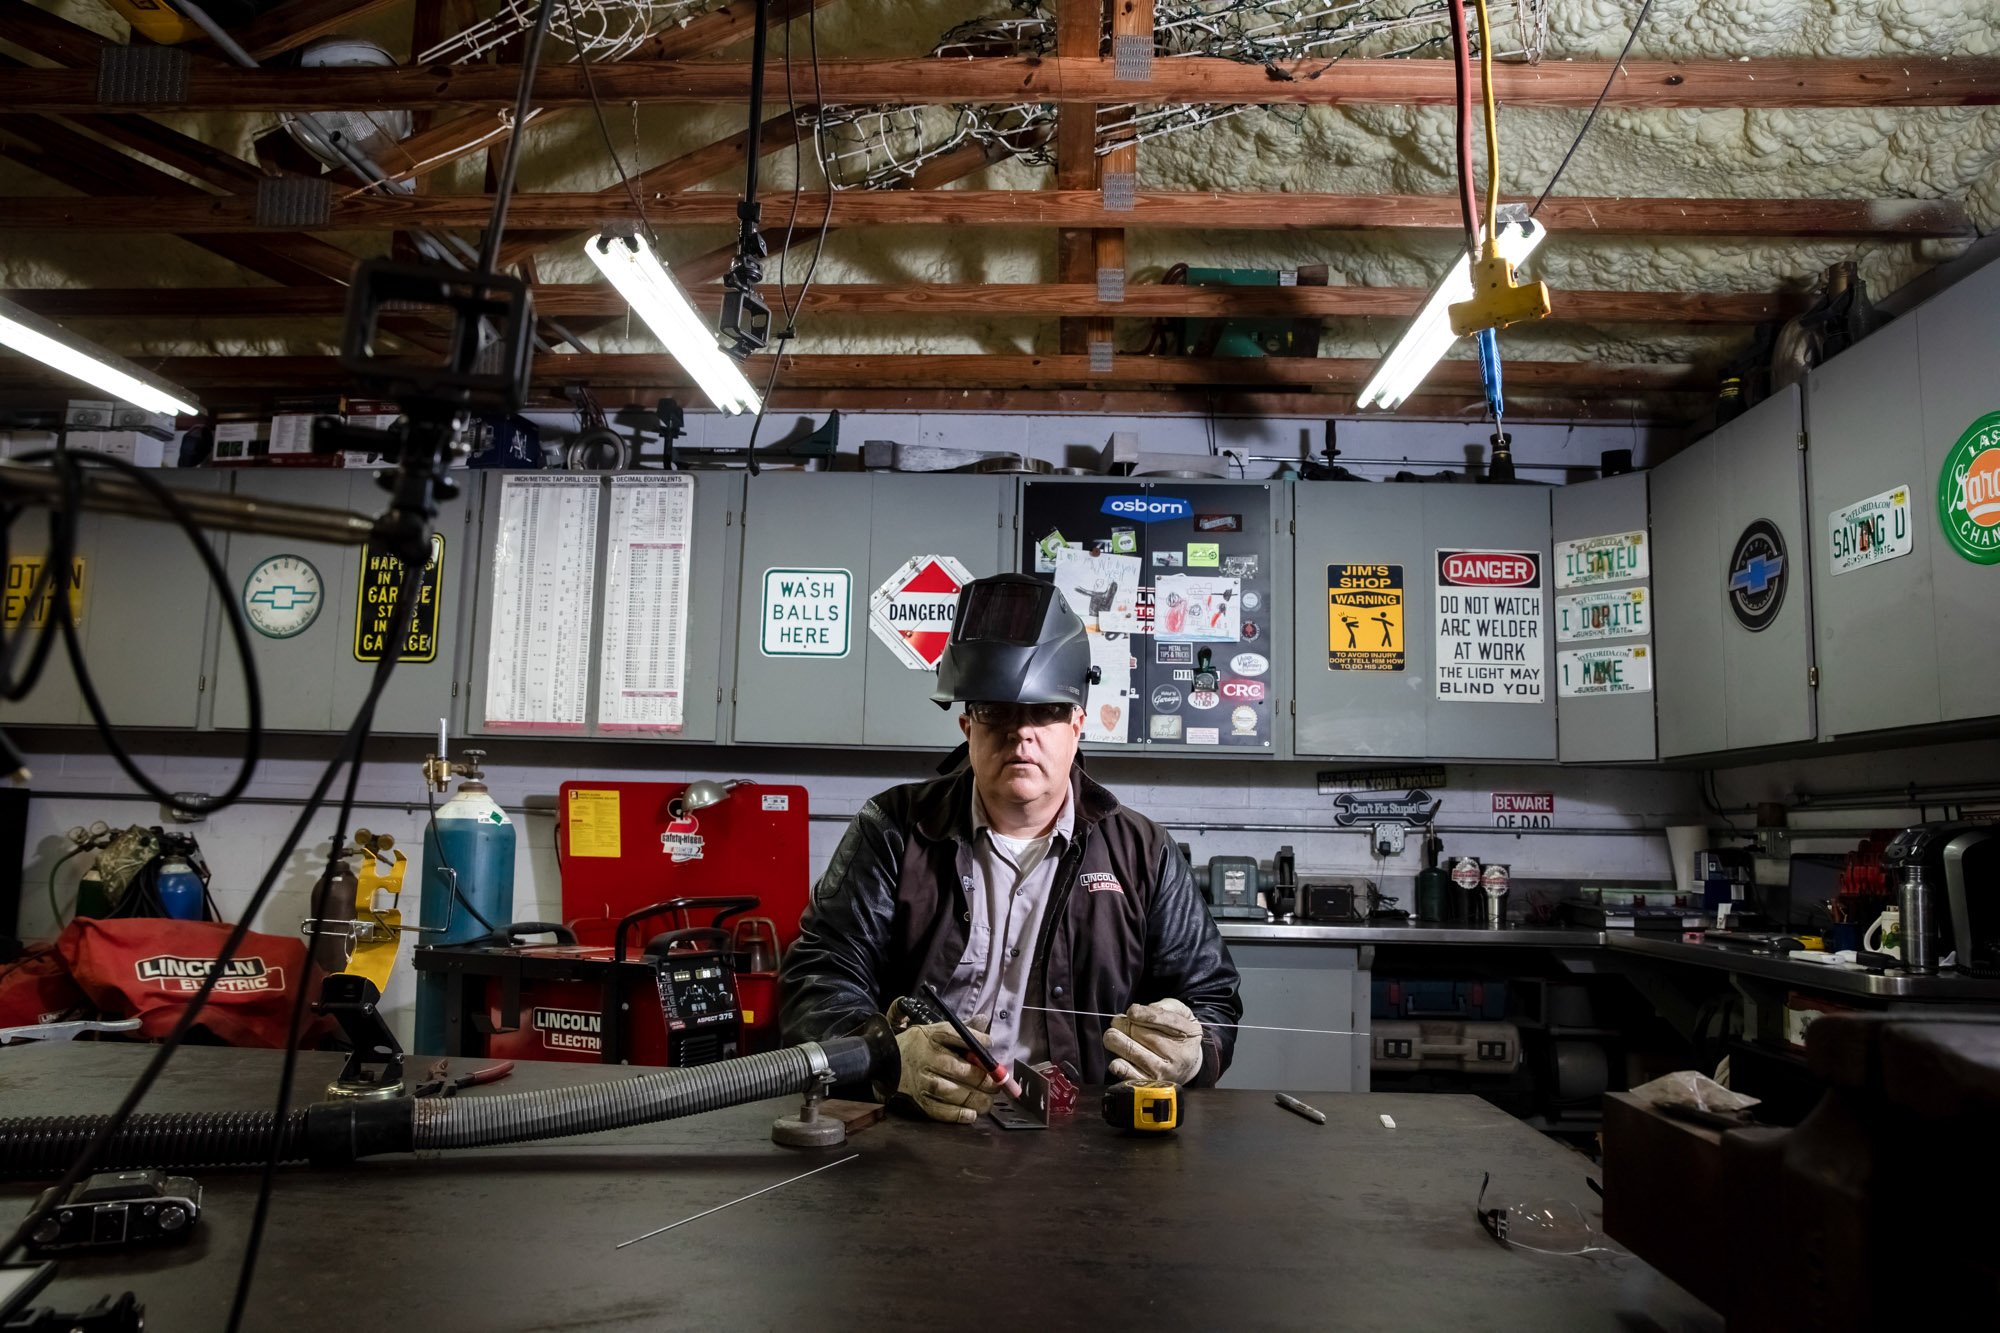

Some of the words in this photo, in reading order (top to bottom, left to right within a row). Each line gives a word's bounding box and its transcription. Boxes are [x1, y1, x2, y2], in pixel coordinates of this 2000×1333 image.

[1111, 498, 1183, 514] osborn
[1833, 513, 1885, 559] SAVING
[1895, 507, 1905, 539] U
[1874, 544, 1891, 558] STATE
[1342, 565, 1389, 576] JIM'S
[1449, 560, 1528, 579] DANGER
[1575, 573, 1605, 583] SUNSHINE
[1607, 570, 1627, 579] STATE
[7, 564, 41, 590] OT
[378, 571, 391, 585] IN
[1340, 577, 1391, 588] SHOP
[368, 586, 432, 604] GARE
[781, 581, 835, 599] WASH
[1335, 595, 1397, 605] WARNING
[1440, 595, 1458, 614] DO
[1464, 596, 1489, 615] NOT
[1494, 596, 1540, 616] WATCH
[773, 604, 839, 621] BALLS
[889, 603, 955, 621] DANGERO
[374, 619, 387, 633] IN
[1440, 618, 1471, 637] ARC
[1476, 619, 1538, 638] WELDER
[1576, 630, 1606, 638] SUNSHINE
[1608, 626, 1628, 635] STATE
[780, 627, 829, 644] HERE
[363, 634, 429, 652] GAGE
[1454, 642, 1472, 660] AT
[1478, 642, 1526, 661] WORK
[1439, 666, 1463, 678] THE
[1467, 667, 1504, 679] LIGHT
[1510, 668, 1540, 680] MAY
[1223, 683, 1261, 697] CRC
[1440, 682, 1494, 694] BLIND
[1503, 683, 1540, 695] YOU
[1577, 686, 1608, 694] SUNSHINE
[1609, 683, 1630, 692] STATE
[1369, 777, 1398, 790] YOUR
[1351, 803, 1374, 814] Can't
[1374, 803, 1389, 814] Fix
[1389, 803, 1418, 816] Stupid
[1495, 796, 1551, 810] BEWARE
[1496, 815, 1515, 828] OF
[1521, 815, 1550, 828] DAD
[179, 978, 269, 991] ELCTRIC
[537, 1012, 600, 1033] LINCOLN
[697, 1015, 718, 1023] ASPECT
[719, 1012, 733, 1020] 375
[552, 1033, 601, 1050] ELECTRI
